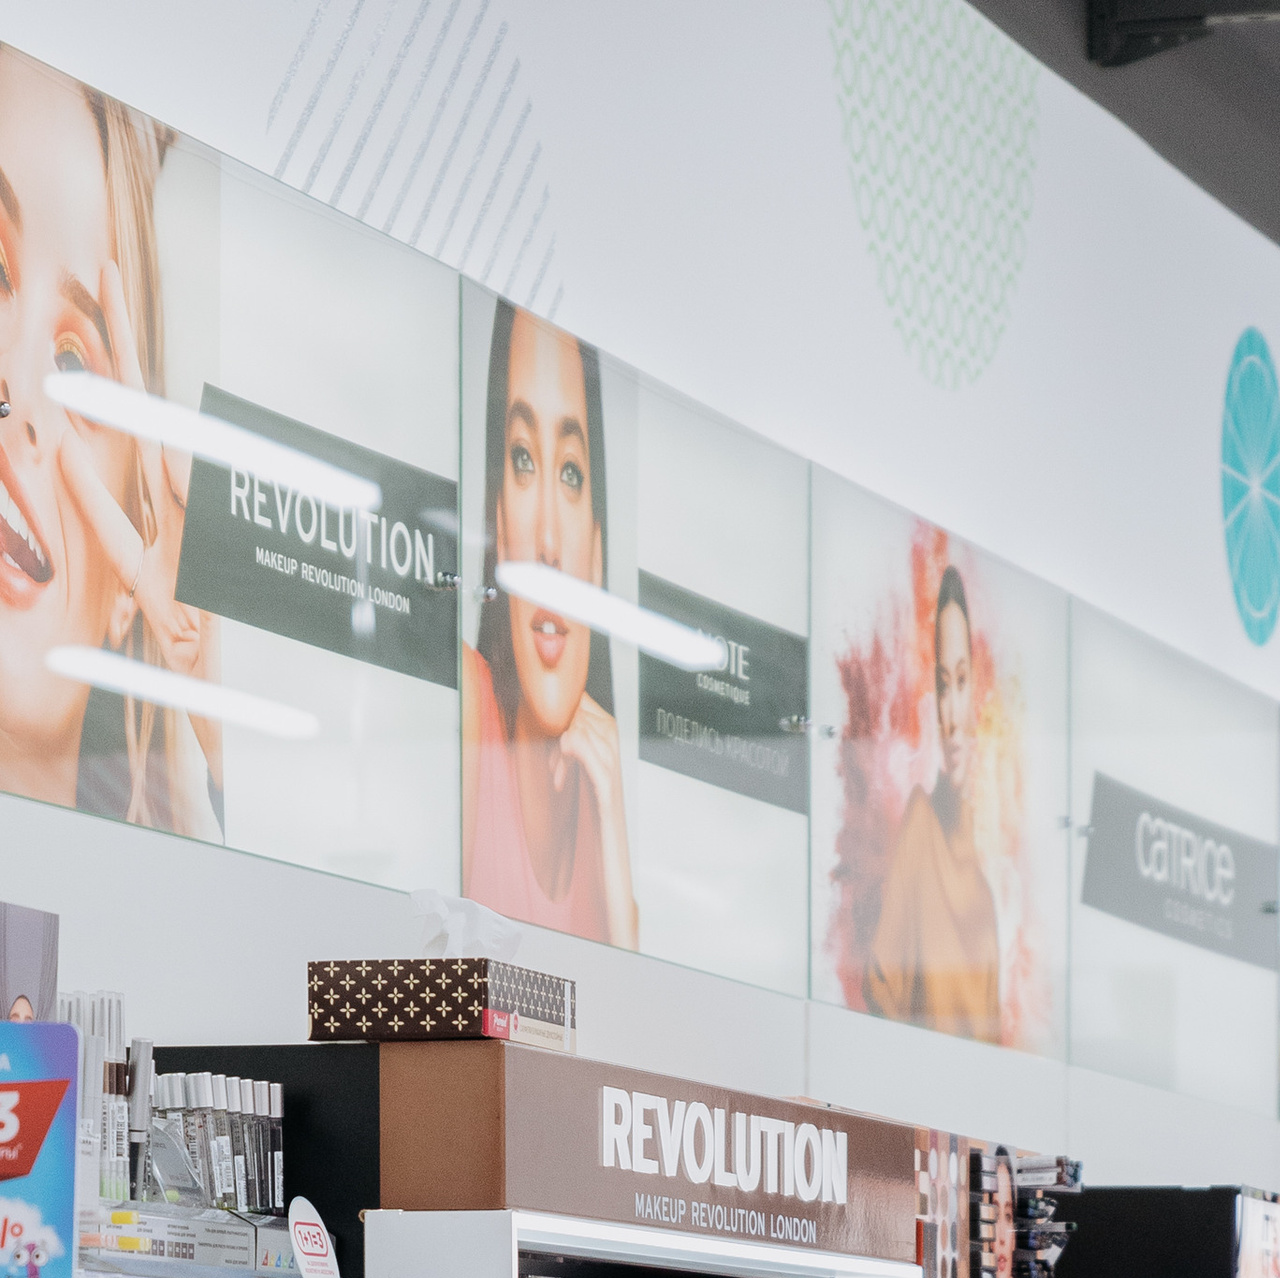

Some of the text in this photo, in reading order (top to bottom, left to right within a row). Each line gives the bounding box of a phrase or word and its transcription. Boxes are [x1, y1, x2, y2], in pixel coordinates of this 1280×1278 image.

[230, 463, 434, 585] REVOLUTION
[256, 546, 410, 614] MAKEUP REVOLUTION LONDON
[697, 630, 750, 681] OTE
[602, 1085, 848, 1206] REVOLUTION
[298, 1230, 325, 1250] 1+1=3
[635, 1192, 817, 1244] MAKEUP REVOLUTION LONDON
